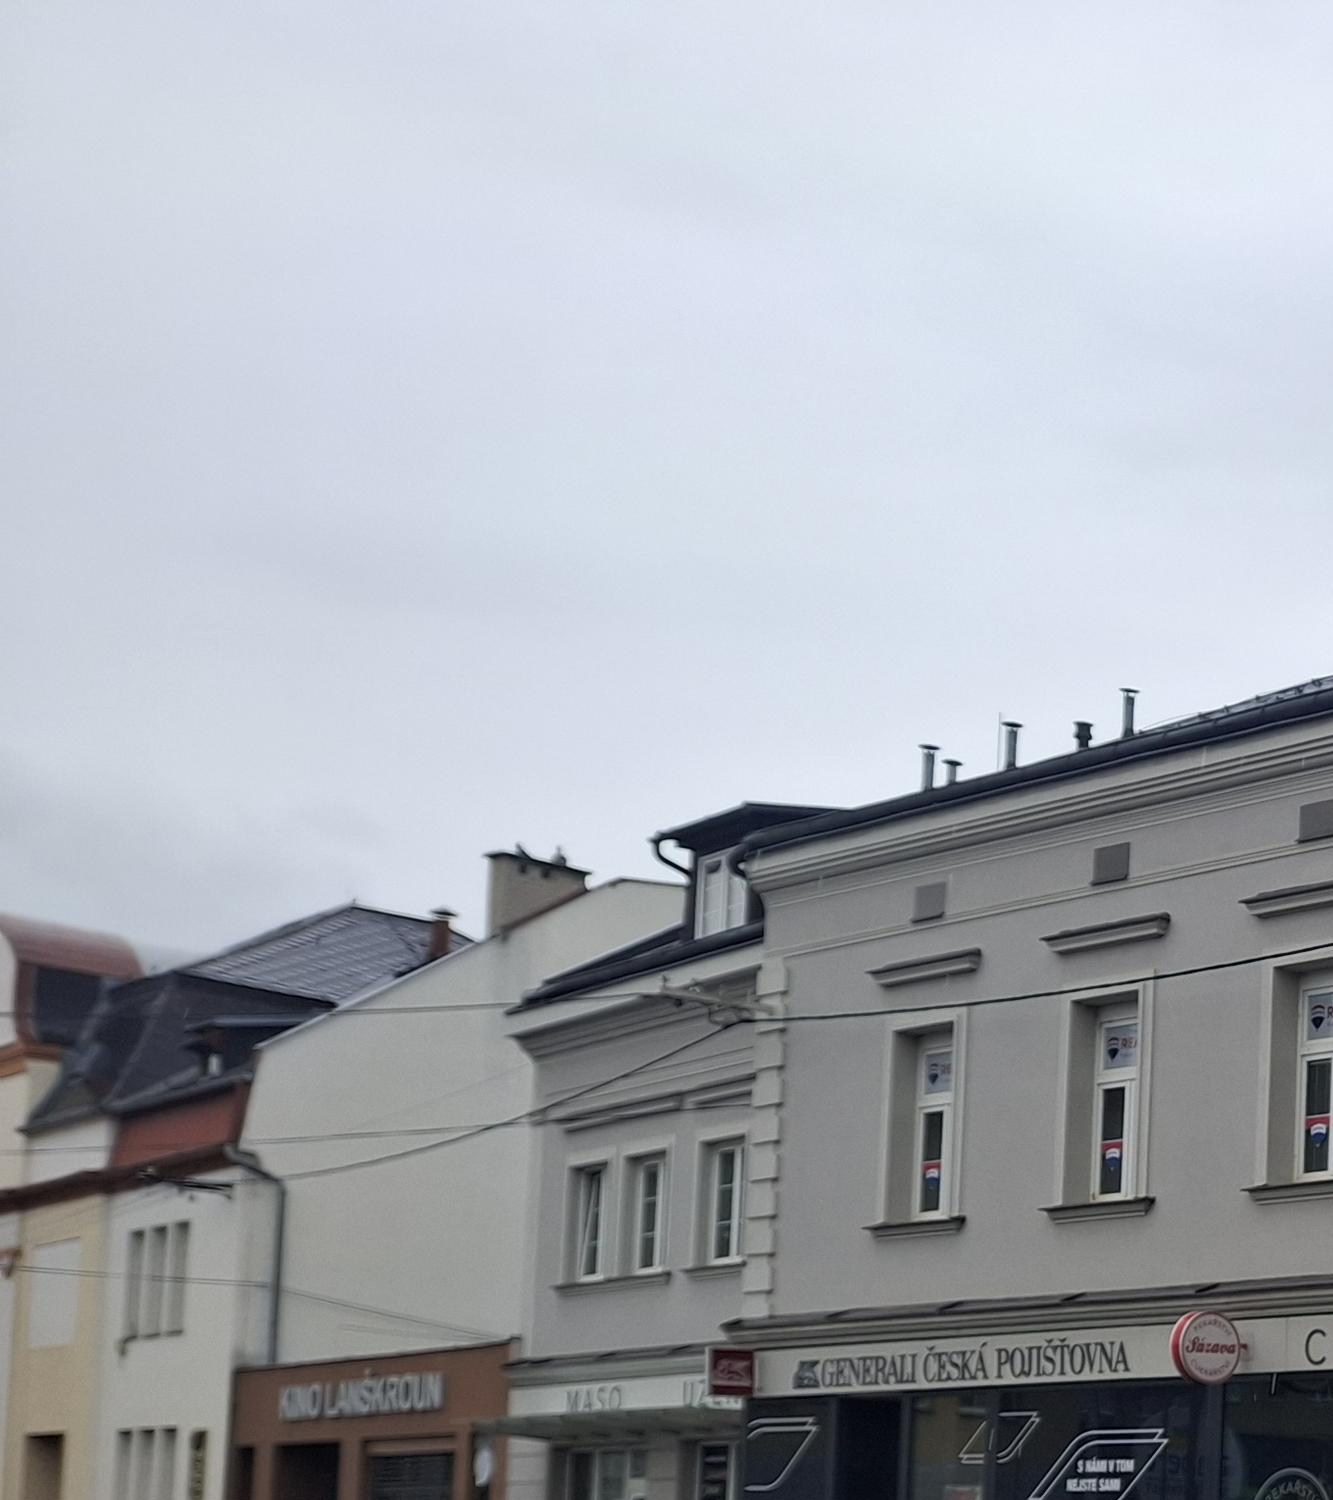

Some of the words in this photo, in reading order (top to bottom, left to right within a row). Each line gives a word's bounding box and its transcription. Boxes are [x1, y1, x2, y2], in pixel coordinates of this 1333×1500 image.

[1185, 1336, 1237, 1355] Sázava
[820, 1352, 918, 1388] GENERALI
[922, 1341, 989, 1383] ČESKÁ
[994, 1337, 1131, 1380] POJIŠŤOVNA
[566, 1384, 623, 1413] MASO
[1066, 1477, 1098, 1492] NEJSTE
